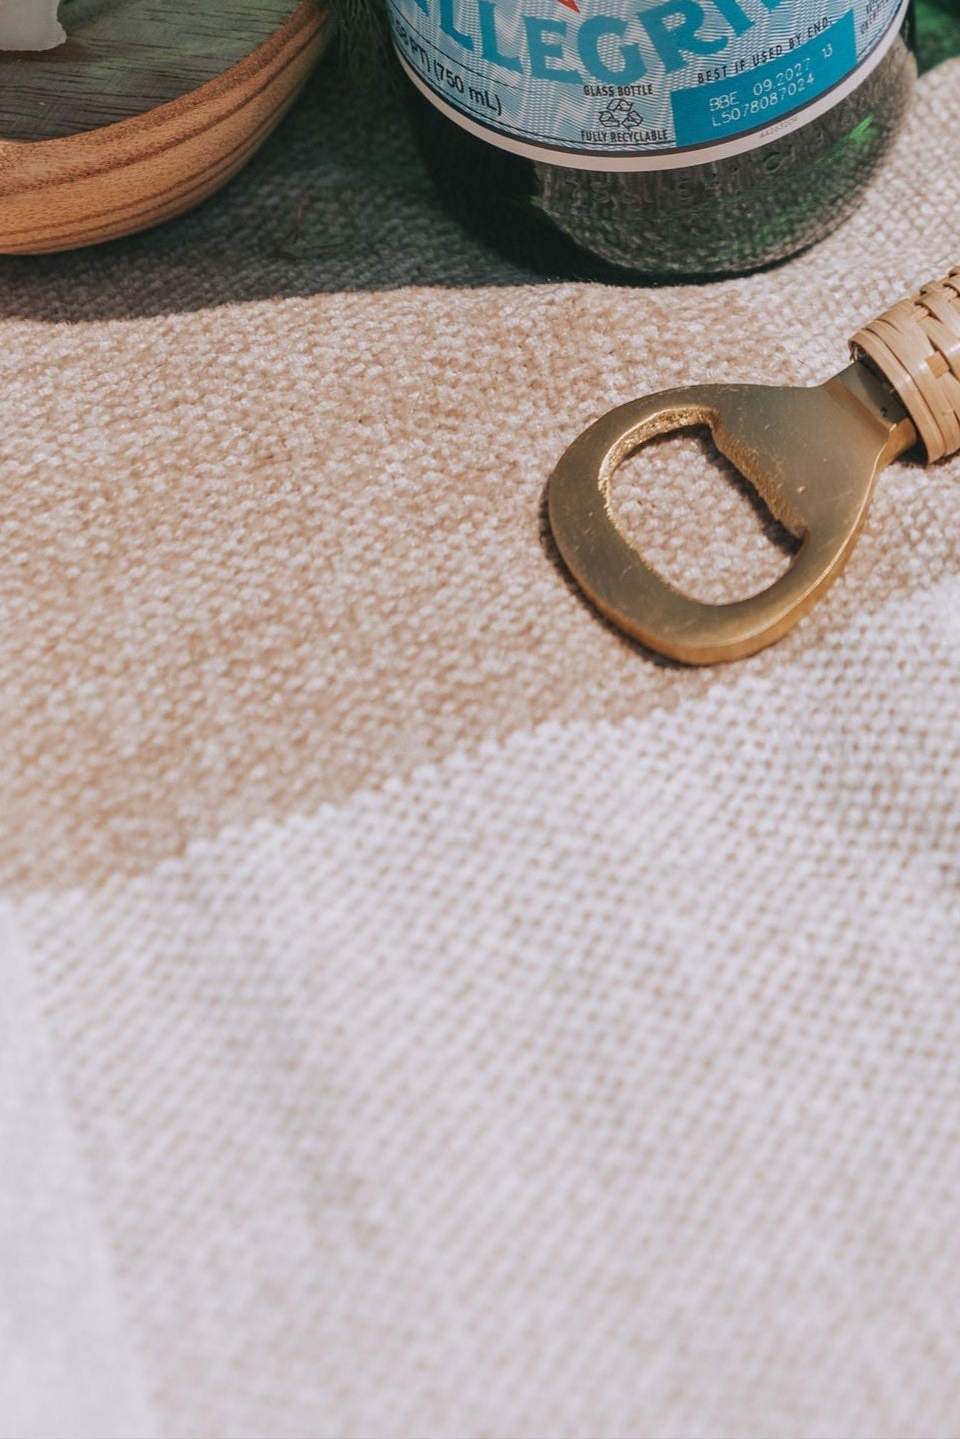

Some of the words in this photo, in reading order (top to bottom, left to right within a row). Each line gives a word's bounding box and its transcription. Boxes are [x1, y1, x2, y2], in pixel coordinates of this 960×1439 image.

[697, 65, 729, 85] BEST
[734, 59, 747, 74] IF
[752, 44, 783, 67] USED
[788, 33, 803, 50] BY
[807, 15, 833, 39] END:
[433, 59, 465, 94] (750
[468, 86, 502, 117] mL)
[582, 84, 616, 97] GLASS
[617, 84, 654, 97] BOTTLE
[708, 90, 741, 112] BBE
[581, 130, 608, 142] FULLY
[610, 128, 669, 142] RECYCLABLE
